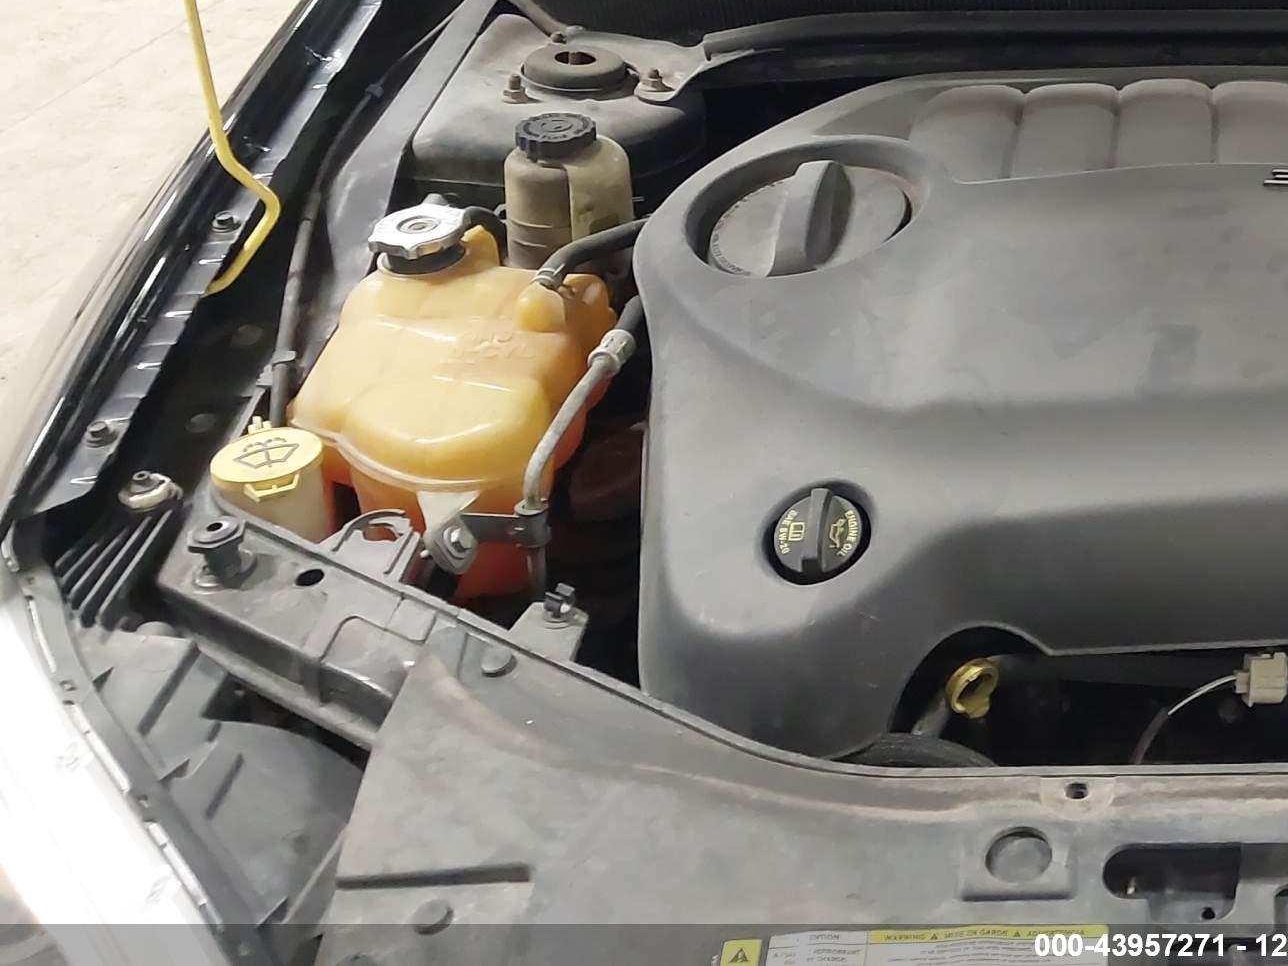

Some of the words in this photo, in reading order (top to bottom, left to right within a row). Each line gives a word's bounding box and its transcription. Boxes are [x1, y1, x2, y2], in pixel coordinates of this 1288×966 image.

[782, 509, 799, 525] SAE
[844, 510, 859, 542] ENGINE
[778, 527, 791, 554] 5W-20
[836, 543, 853, 556] OIL
